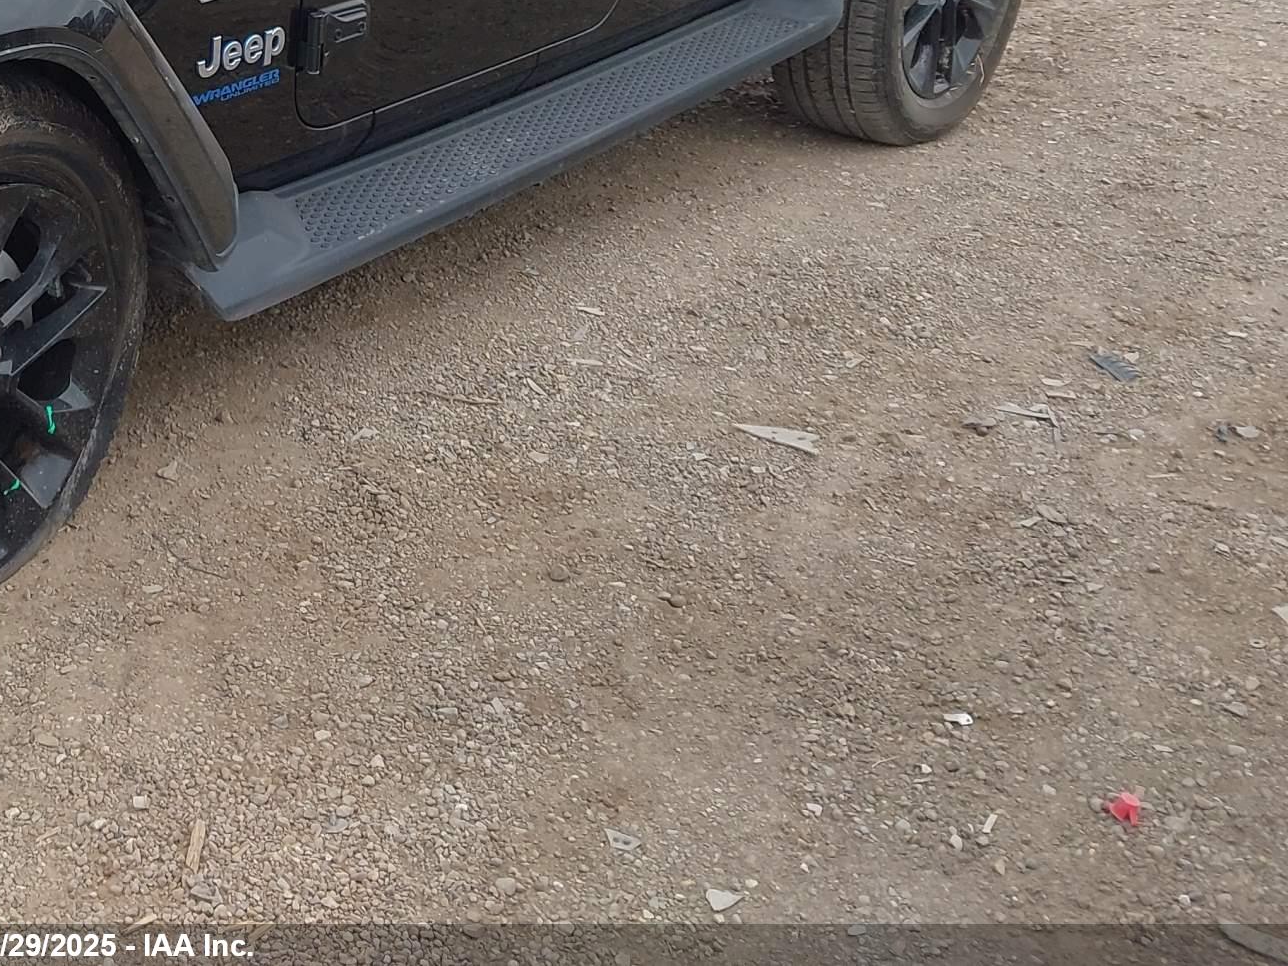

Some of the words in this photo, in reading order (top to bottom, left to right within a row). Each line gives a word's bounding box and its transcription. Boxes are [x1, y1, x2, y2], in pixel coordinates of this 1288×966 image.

[197, 26, 286, 78] Jeep
[191, 68, 281, 107] WRANGLER
[220, 77, 281, 102] UNLIMITED
